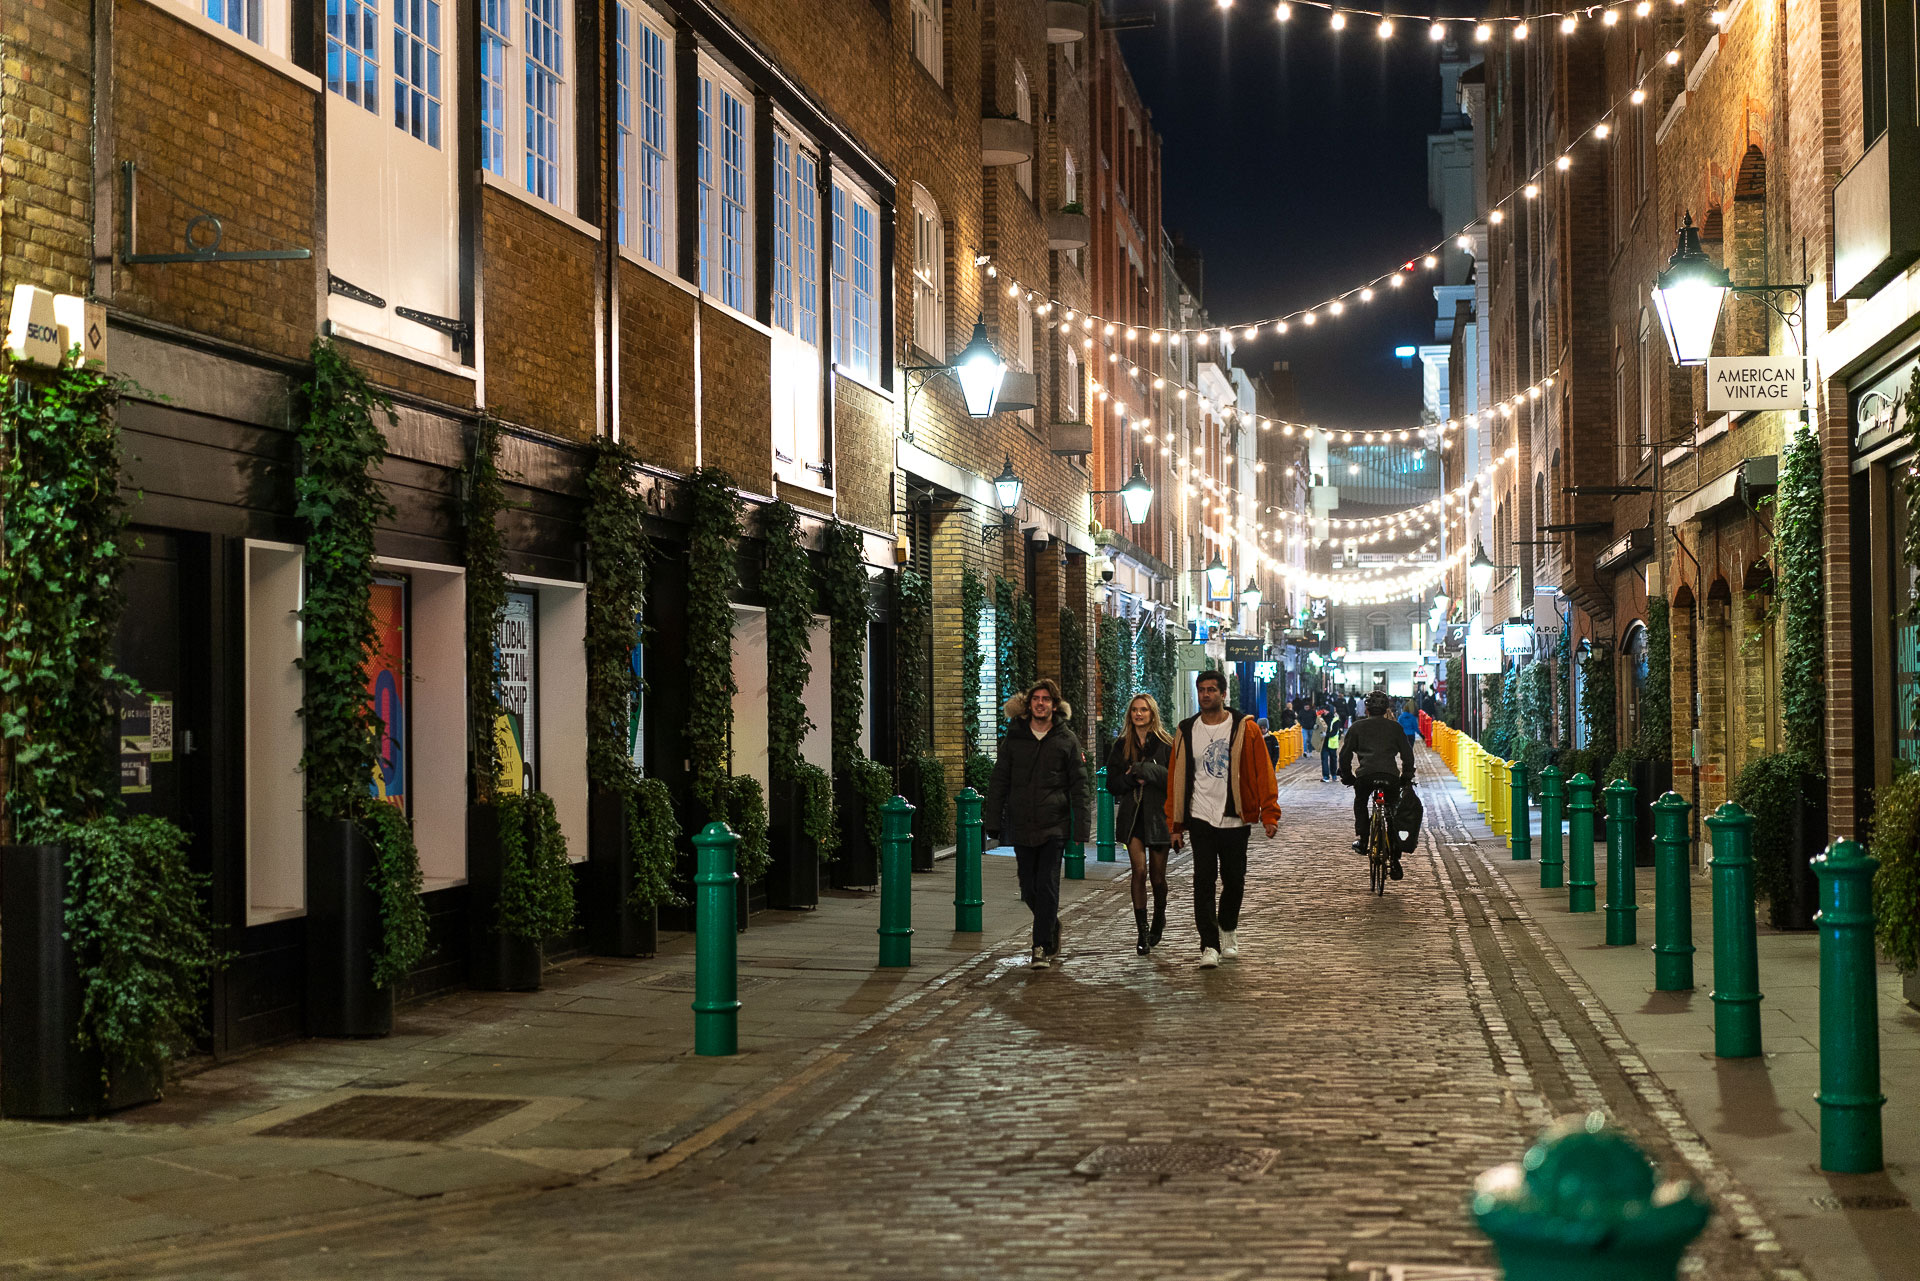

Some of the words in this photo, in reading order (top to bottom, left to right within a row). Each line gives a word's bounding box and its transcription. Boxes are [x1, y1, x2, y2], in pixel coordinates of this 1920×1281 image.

[27, 322, 58, 344] SECOM
[1717, 367, 1796, 383] AMERICAN
[1725, 384, 1788, 399] VINTAGE
[1535, 626, 1560, 634] A.P.C.
[1505, 646, 1532, 655] GANNI
